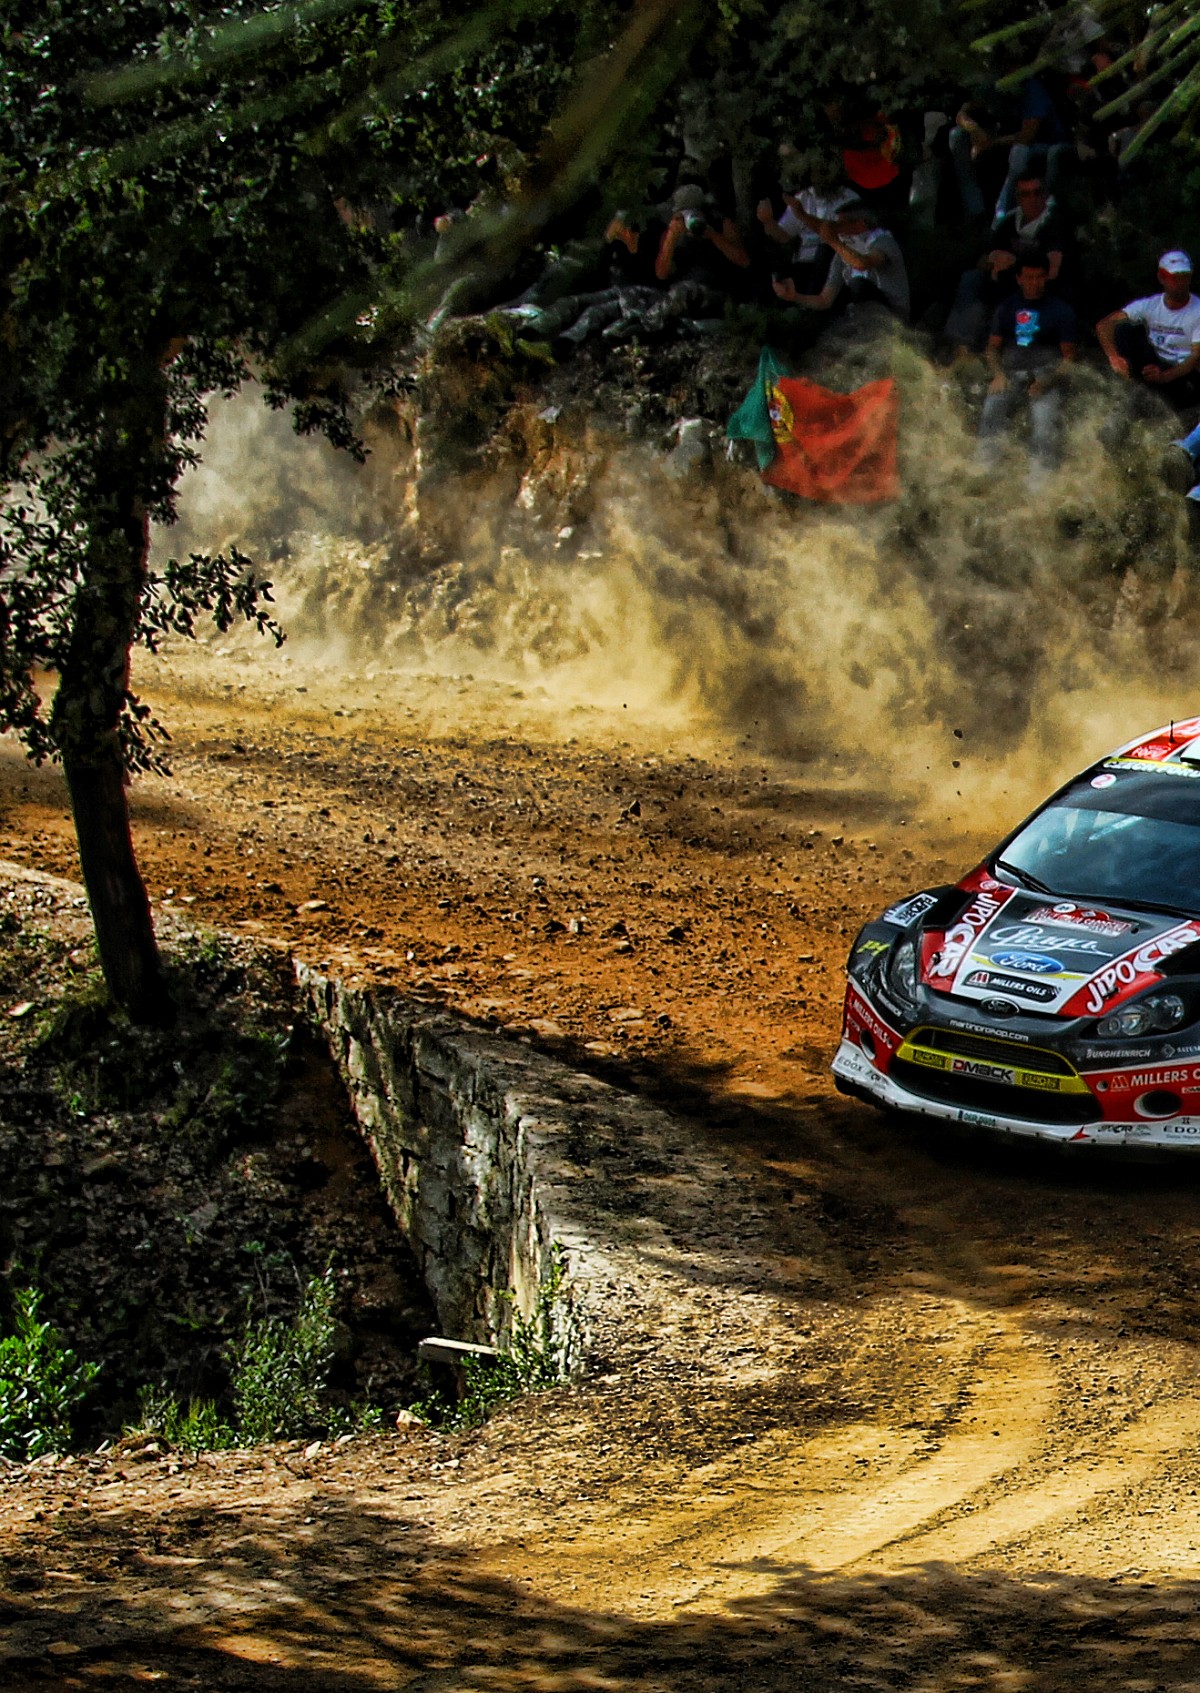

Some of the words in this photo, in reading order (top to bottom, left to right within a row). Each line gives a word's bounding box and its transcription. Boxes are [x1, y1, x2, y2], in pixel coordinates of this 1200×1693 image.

[989, 925, 1114, 957] Praga
[999, 954, 1054, 975] Ford
[991, 978, 1028, 993] MILLERS
[1028, 986, 1048, 998] OILS
[949, 1018, 1029, 1042] martinprokop.com
[1131, 1069, 1188, 1087] MILLERS
